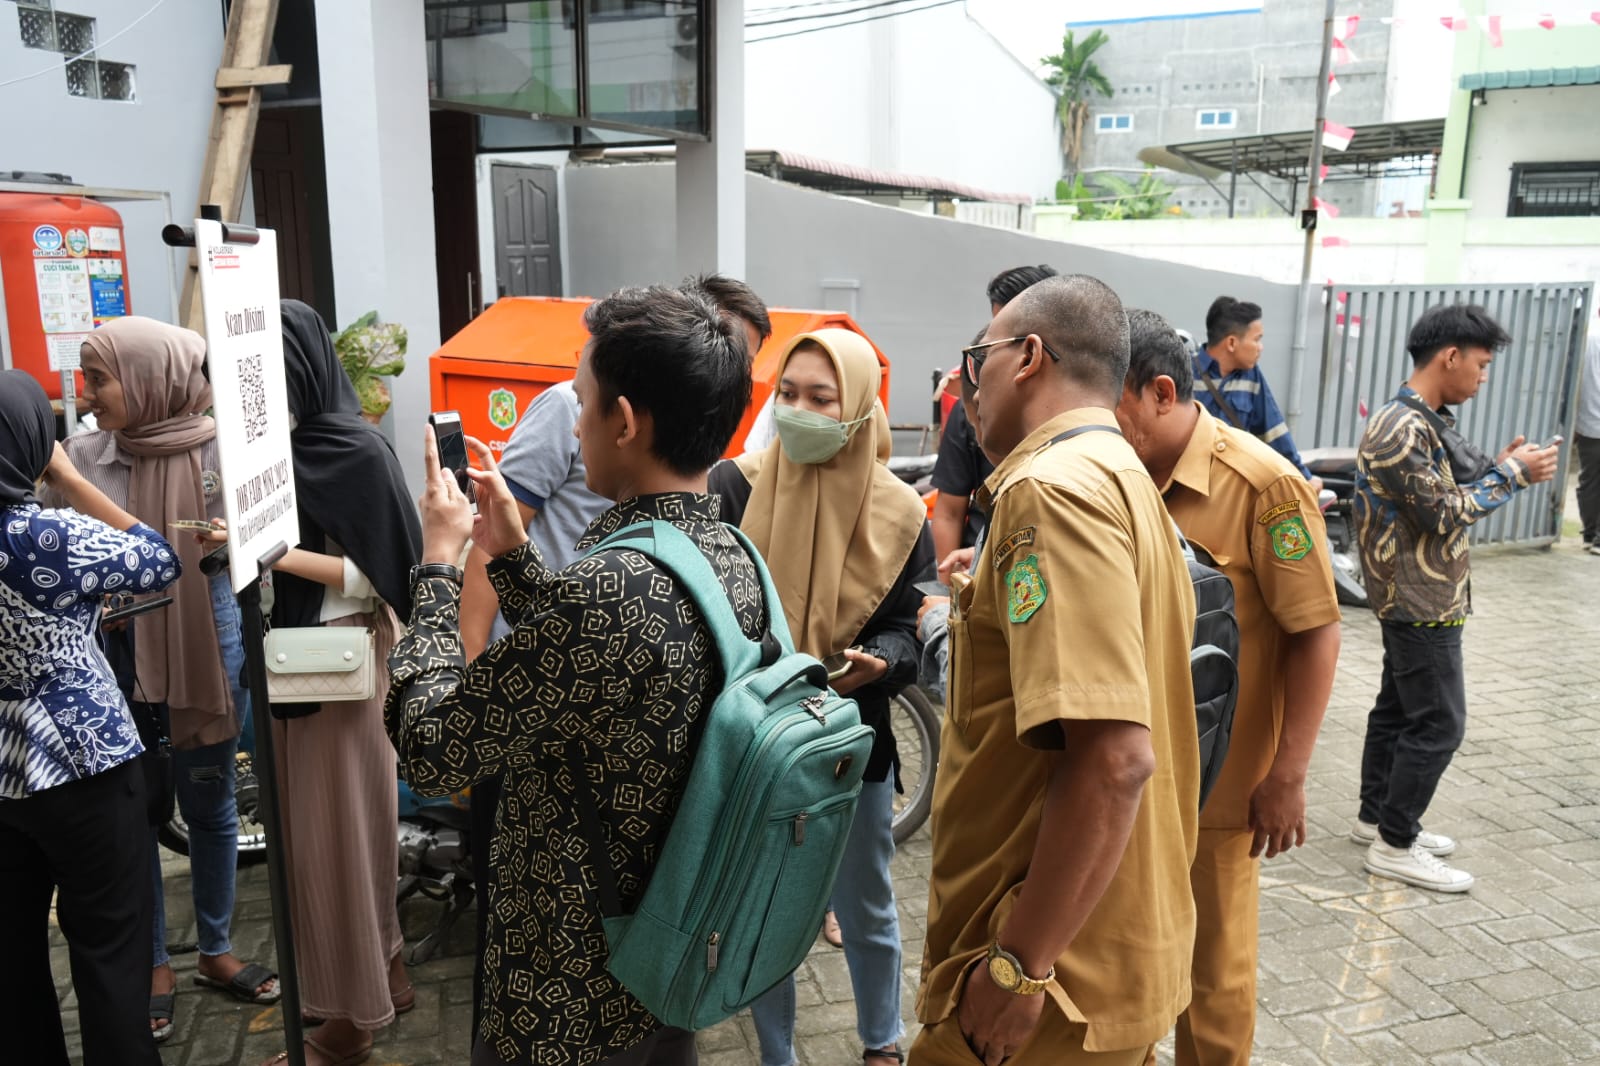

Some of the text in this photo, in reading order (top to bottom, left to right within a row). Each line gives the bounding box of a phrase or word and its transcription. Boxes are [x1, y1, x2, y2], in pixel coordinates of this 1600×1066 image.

[43, 264, 58, 272] CUCI
[225, 305, 266, 338] Scan Disini
[236, 484, 249, 520] JOB
[248, 475, 263, 508] FAIR
[1011, 529, 1034, 547] MEDAN
